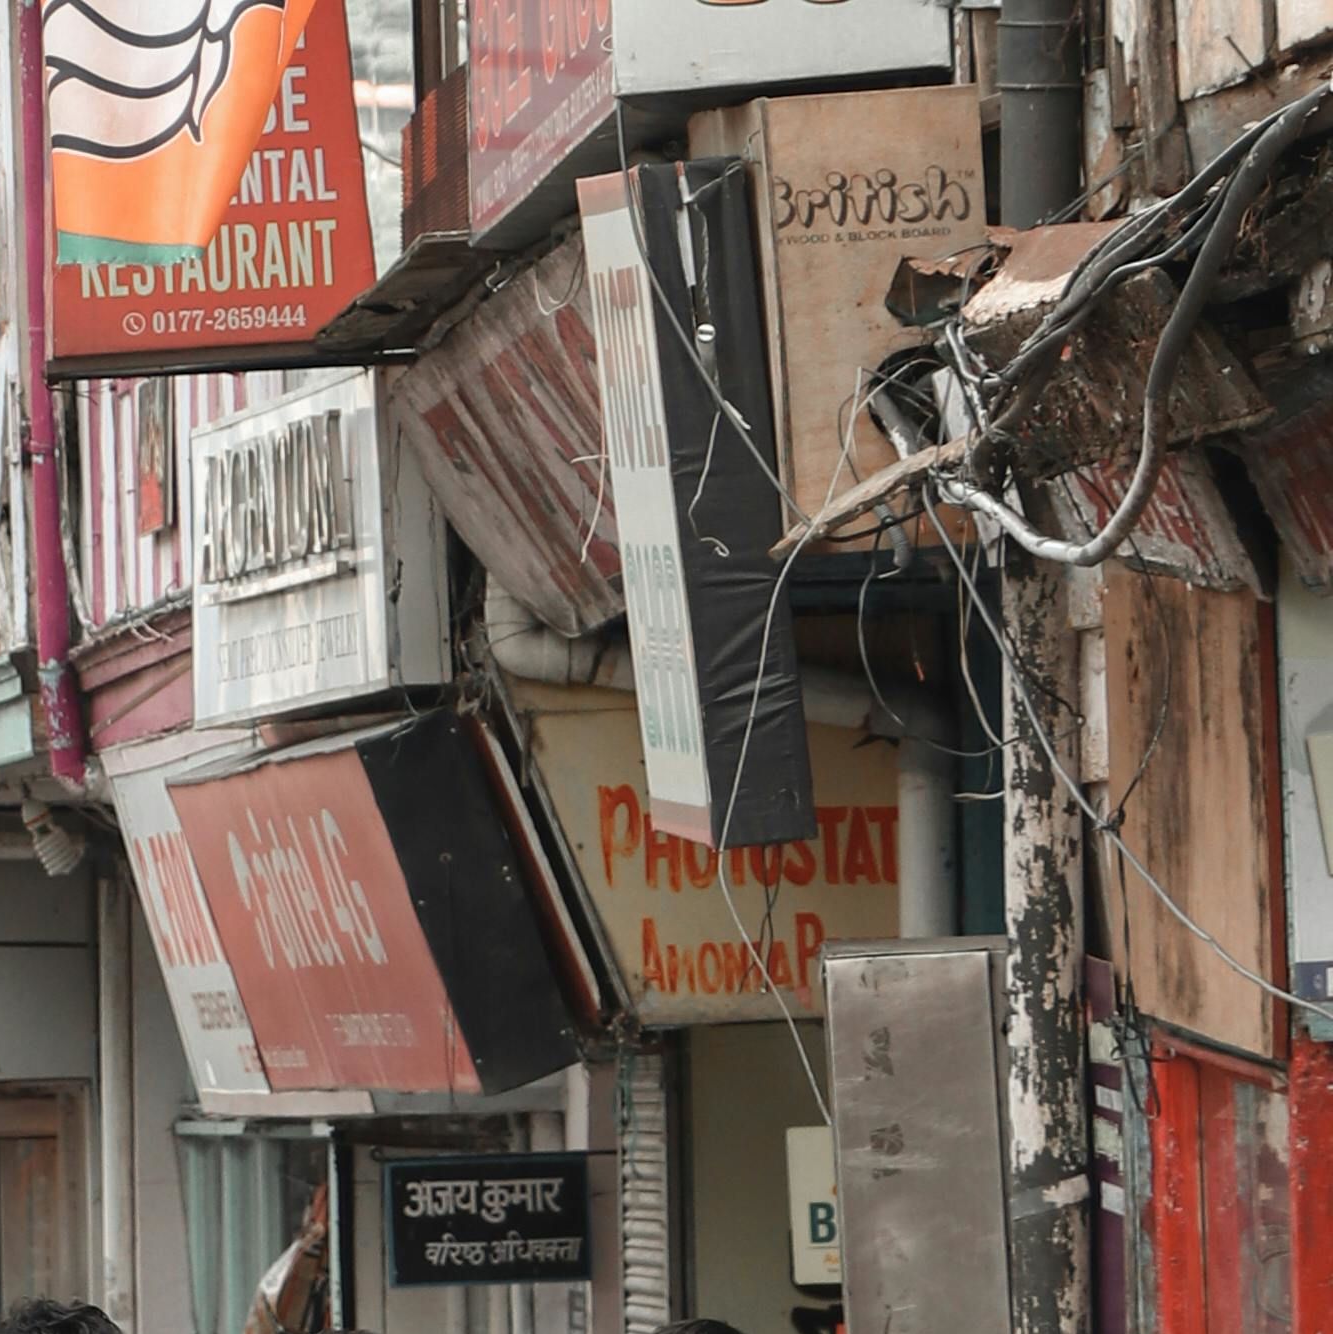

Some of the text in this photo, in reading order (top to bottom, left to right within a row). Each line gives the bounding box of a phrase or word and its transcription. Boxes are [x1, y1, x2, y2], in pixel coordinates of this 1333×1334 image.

[848, 230, 898, 243] BLOCK
[901, 226, 952, 240] BOARD
[152, 304, 307, 334] 0177-2659444
[308, 807, 389, 966] 4G
[403, 1176, 564, 1223] अजय कुमार
